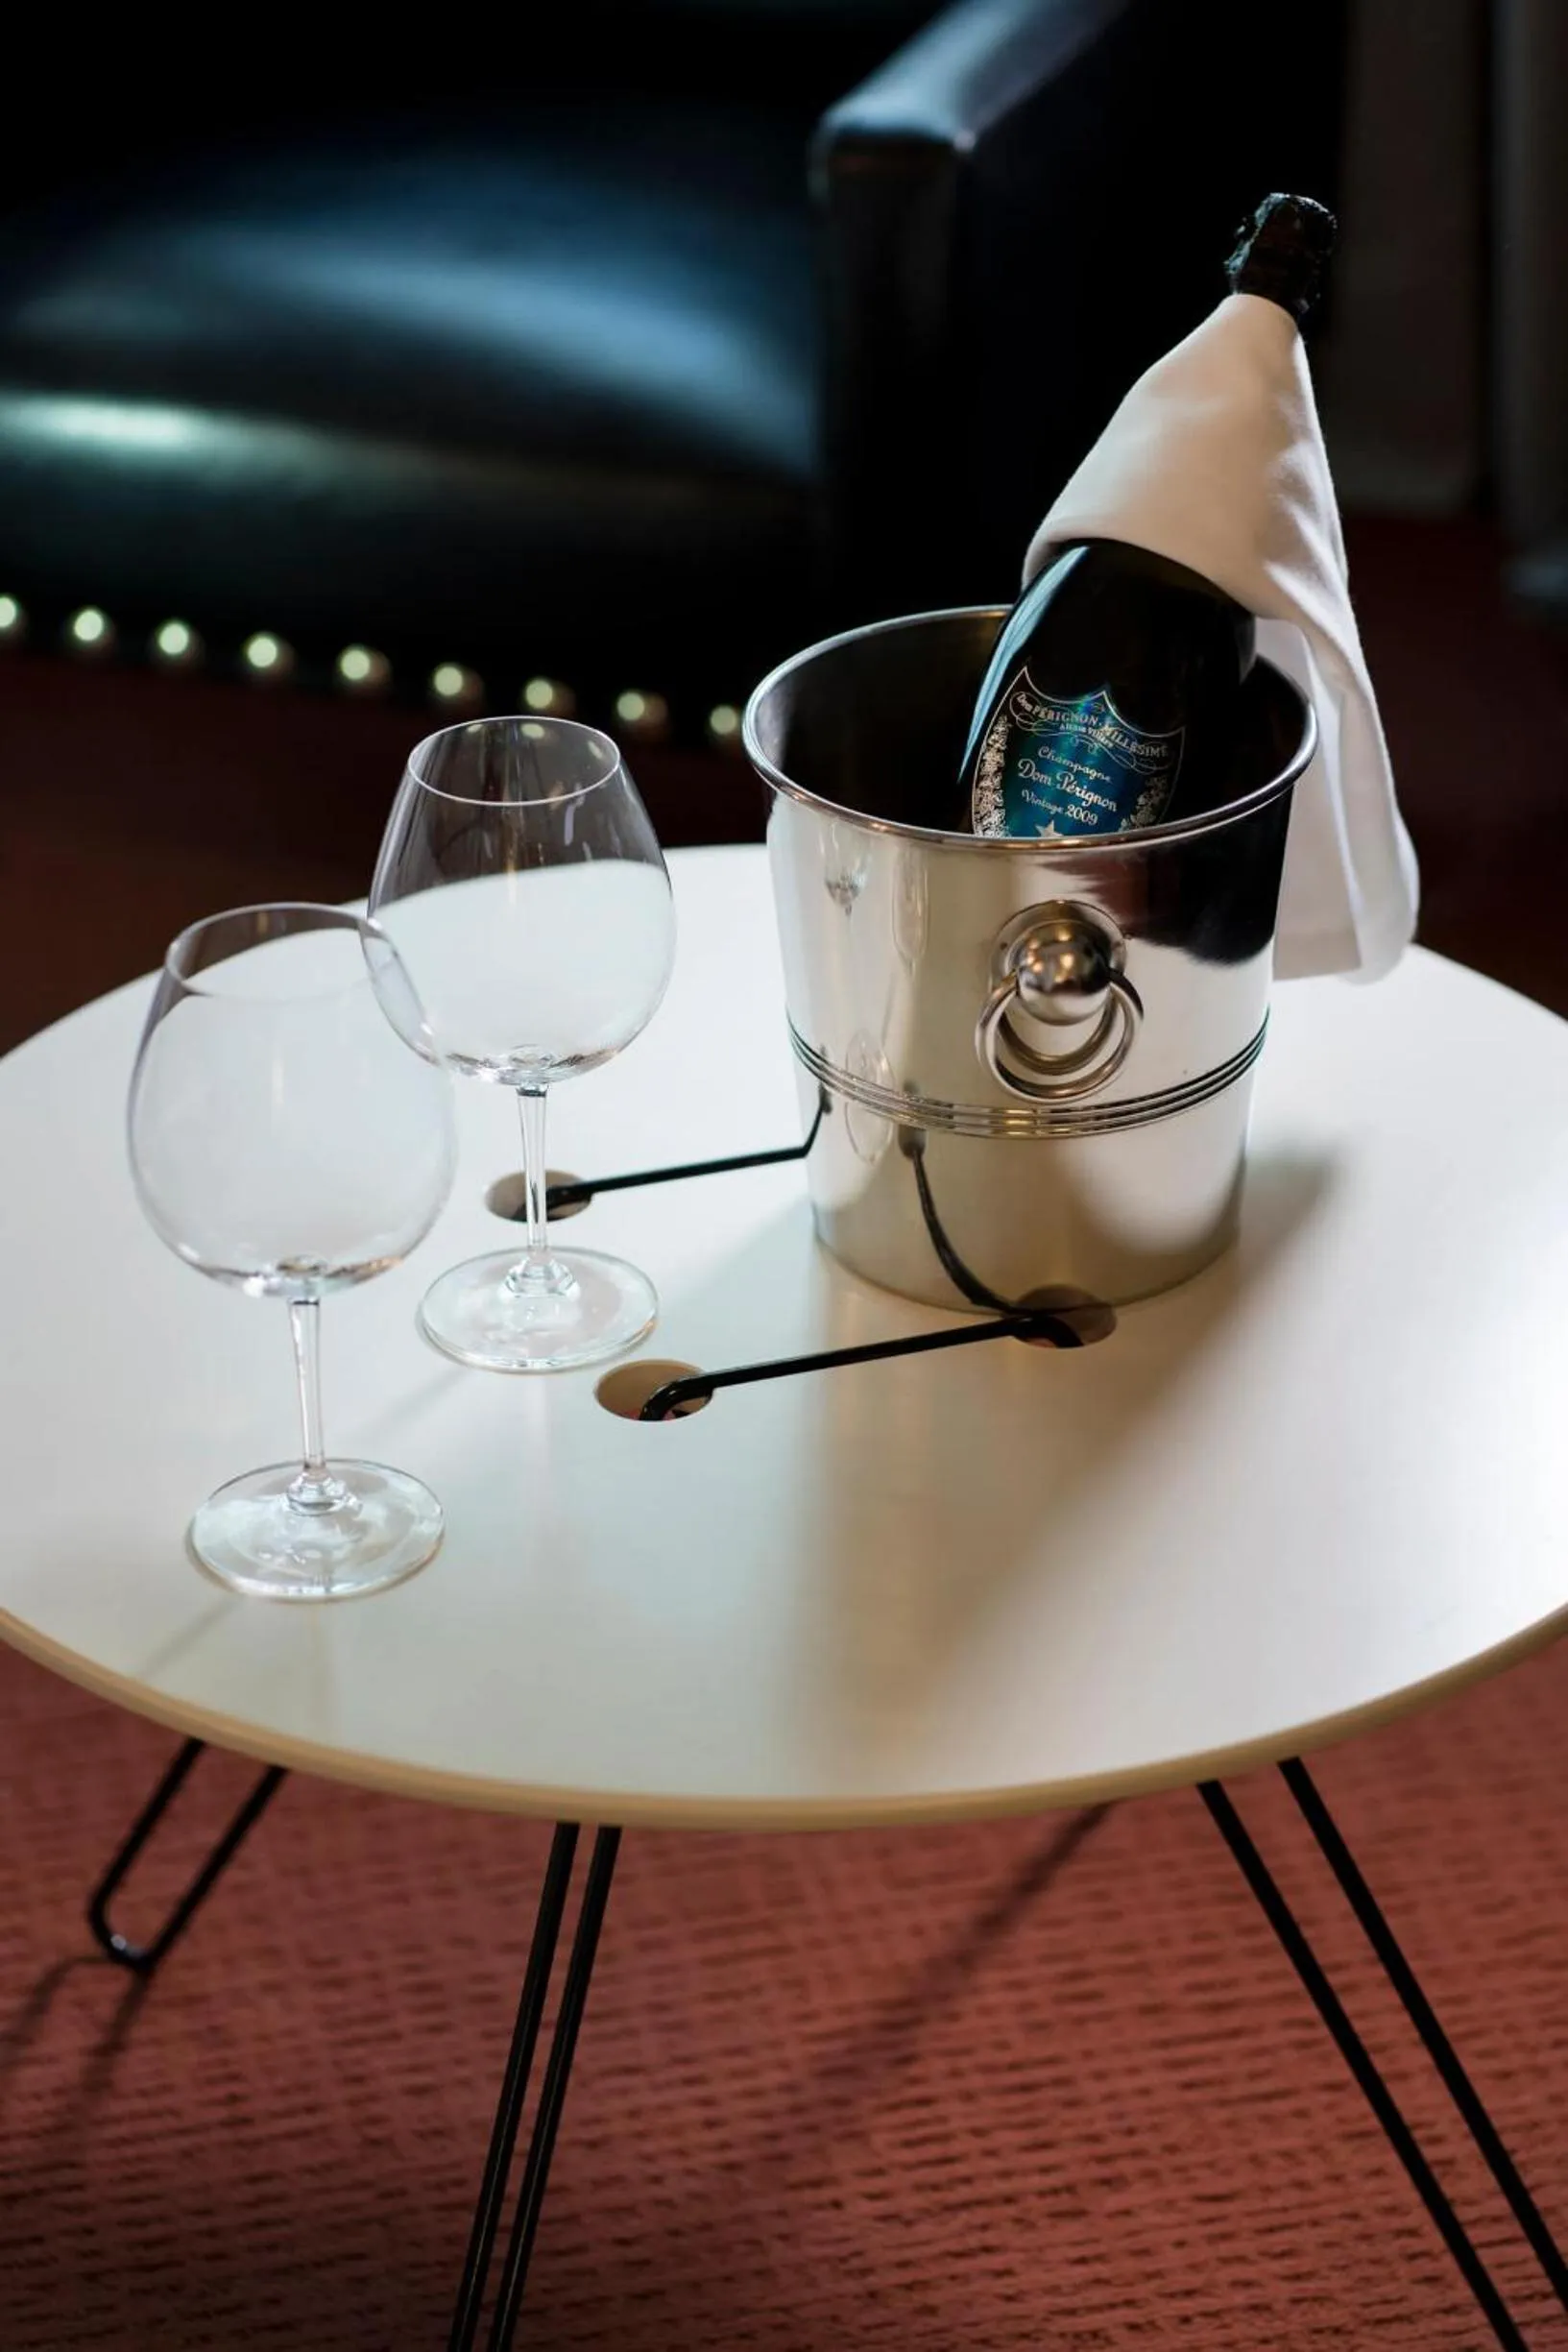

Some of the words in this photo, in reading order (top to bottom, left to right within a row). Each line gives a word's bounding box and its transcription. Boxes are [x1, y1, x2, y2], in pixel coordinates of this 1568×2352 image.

[1038, 745, 1112, 782] Champagne
[1018, 758, 1052, 786] Dom
[1056, 771, 1117, 812] Pérignon
[1021, 788, 1064, 814] Vintage
[1066, 804, 1098, 826] 2009
